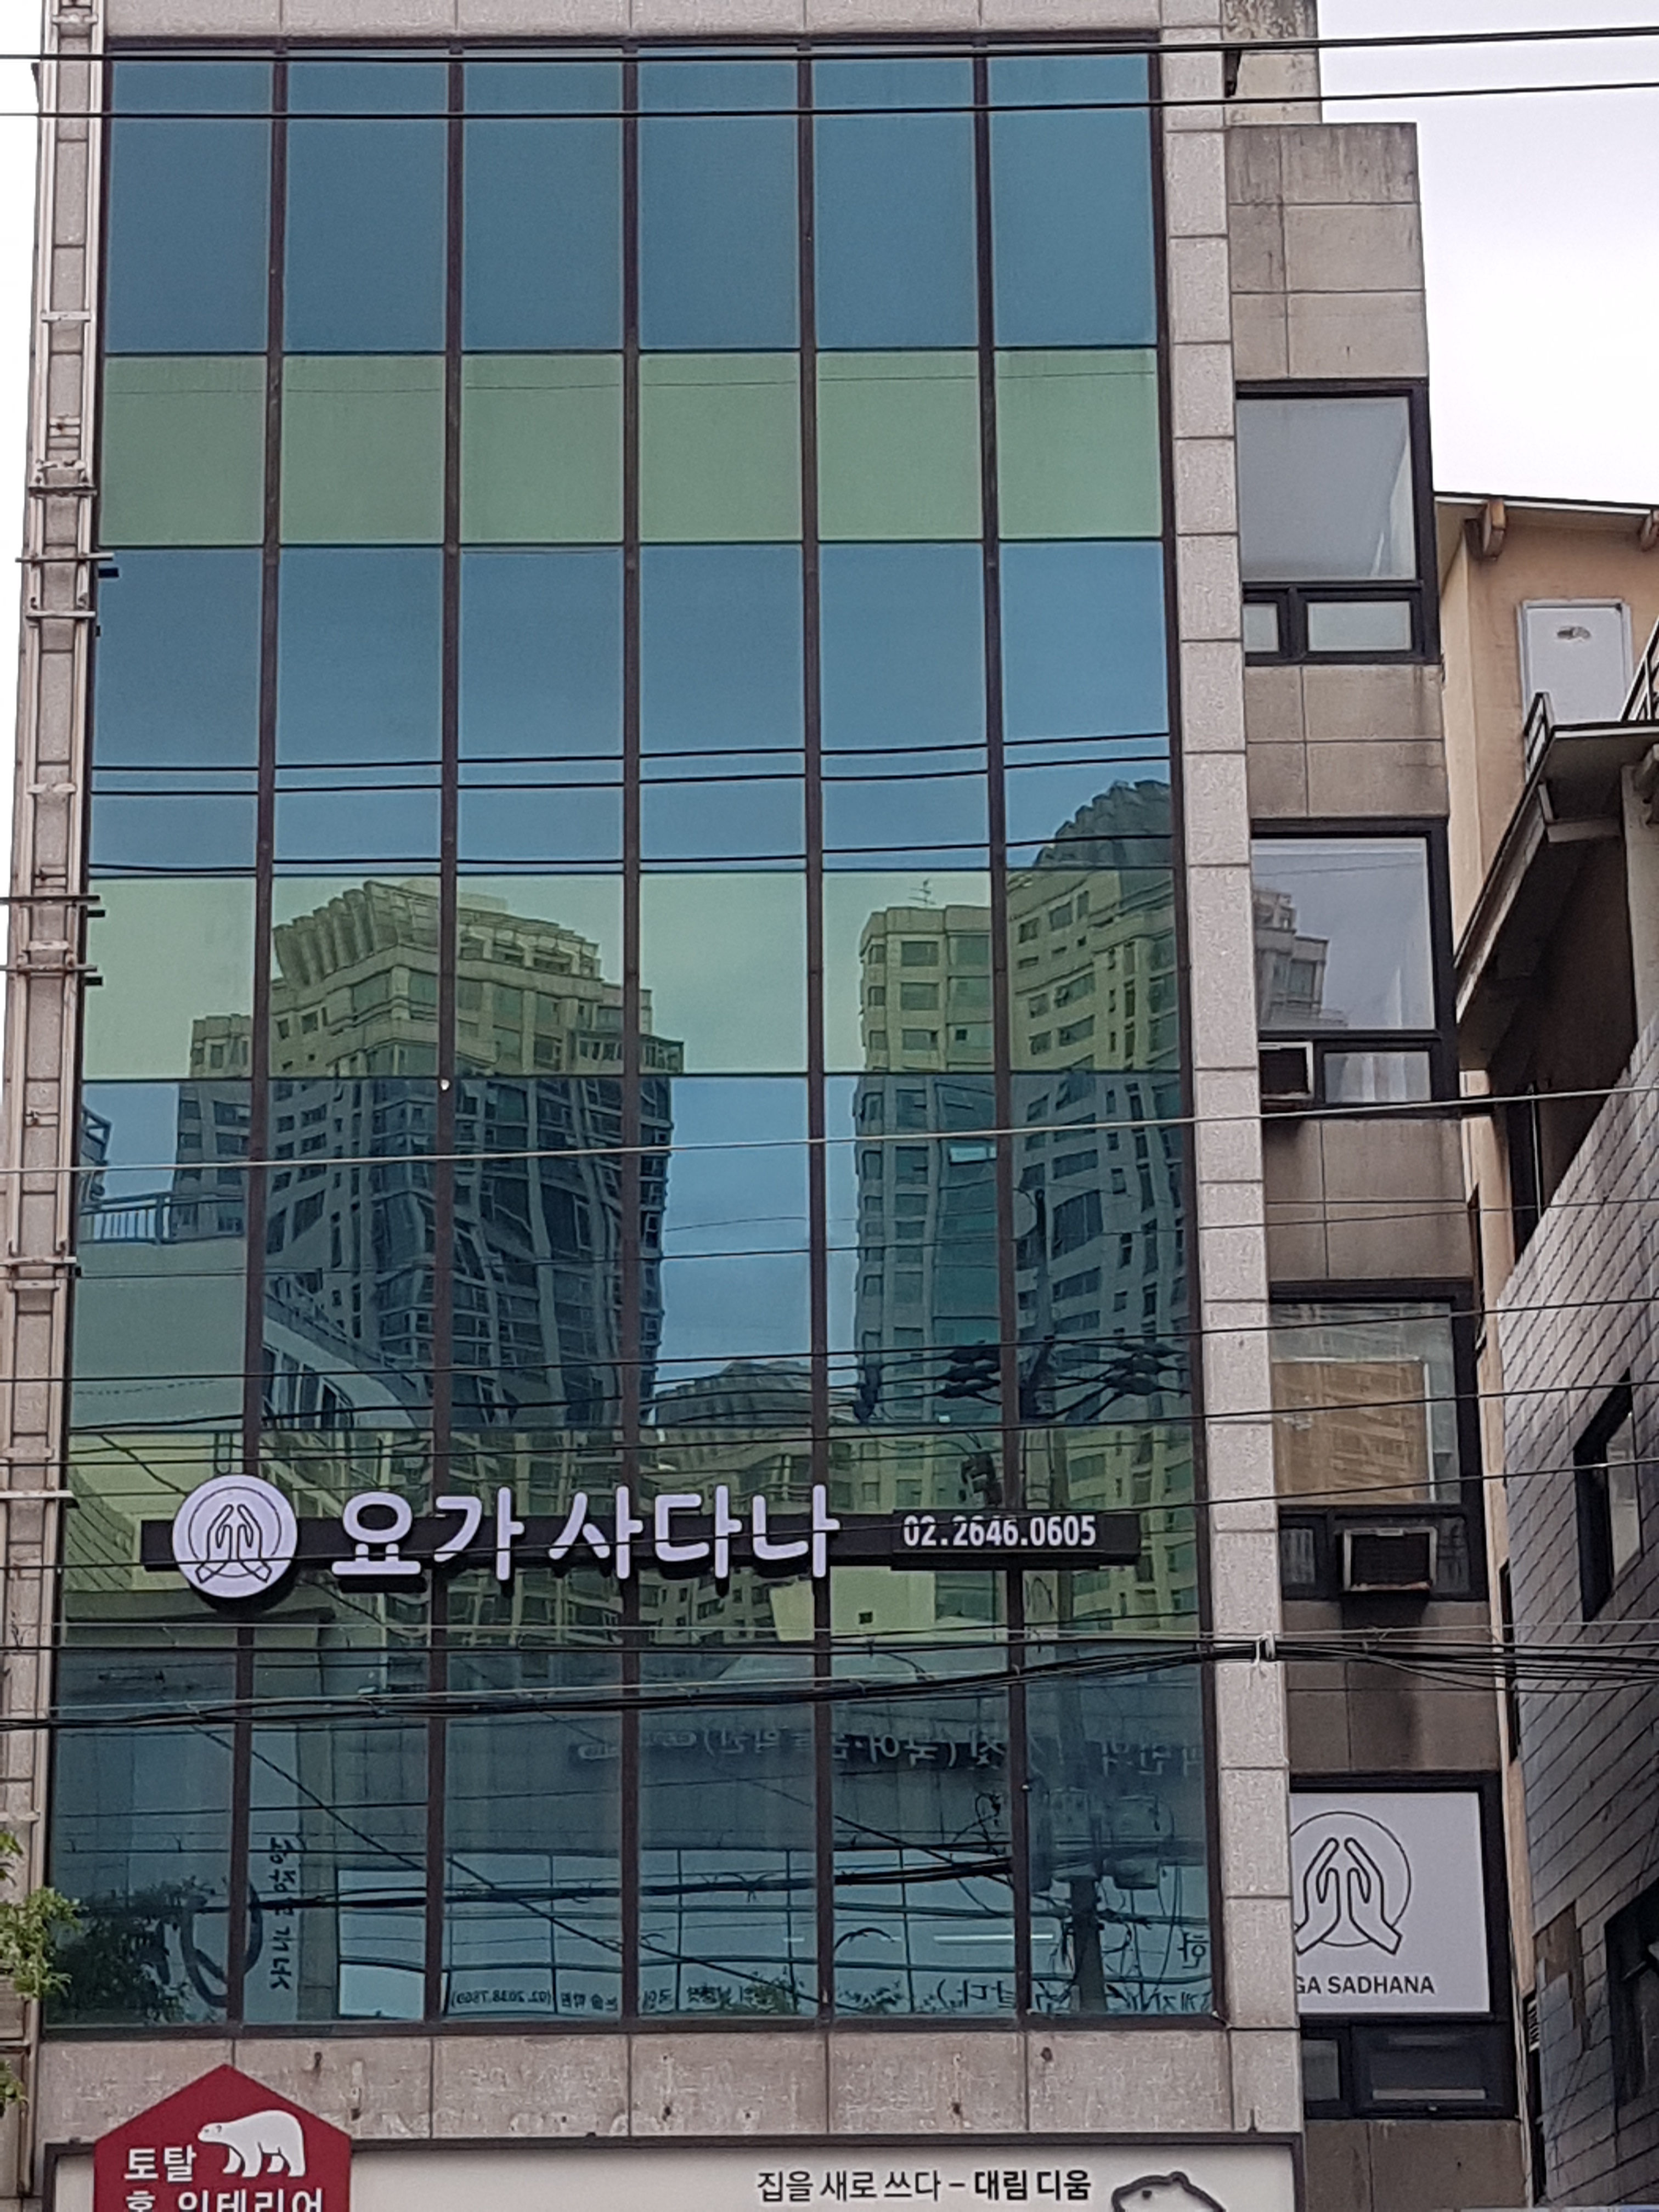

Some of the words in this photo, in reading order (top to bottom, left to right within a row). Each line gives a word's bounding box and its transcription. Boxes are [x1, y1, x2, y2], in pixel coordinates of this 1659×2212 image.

[331, 1485, 525, 1582] 요가
[548, 1484, 840, 1581] 사다나
[903, 1514, 1097, 1547] 02.2646.0605
[1328, 1976, 1435, 1994] SADHANA
[124, 2145, 196, 2182] 토탈
[757, 2170, 814, 2203] 집을
[820, 2170, 877, 2202] 새로
[884, 2170, 941, 2201] 쓰다
[974, 2169, 1028, 2201] 대림
[1036, 2169, 1092, 2201] 디움
